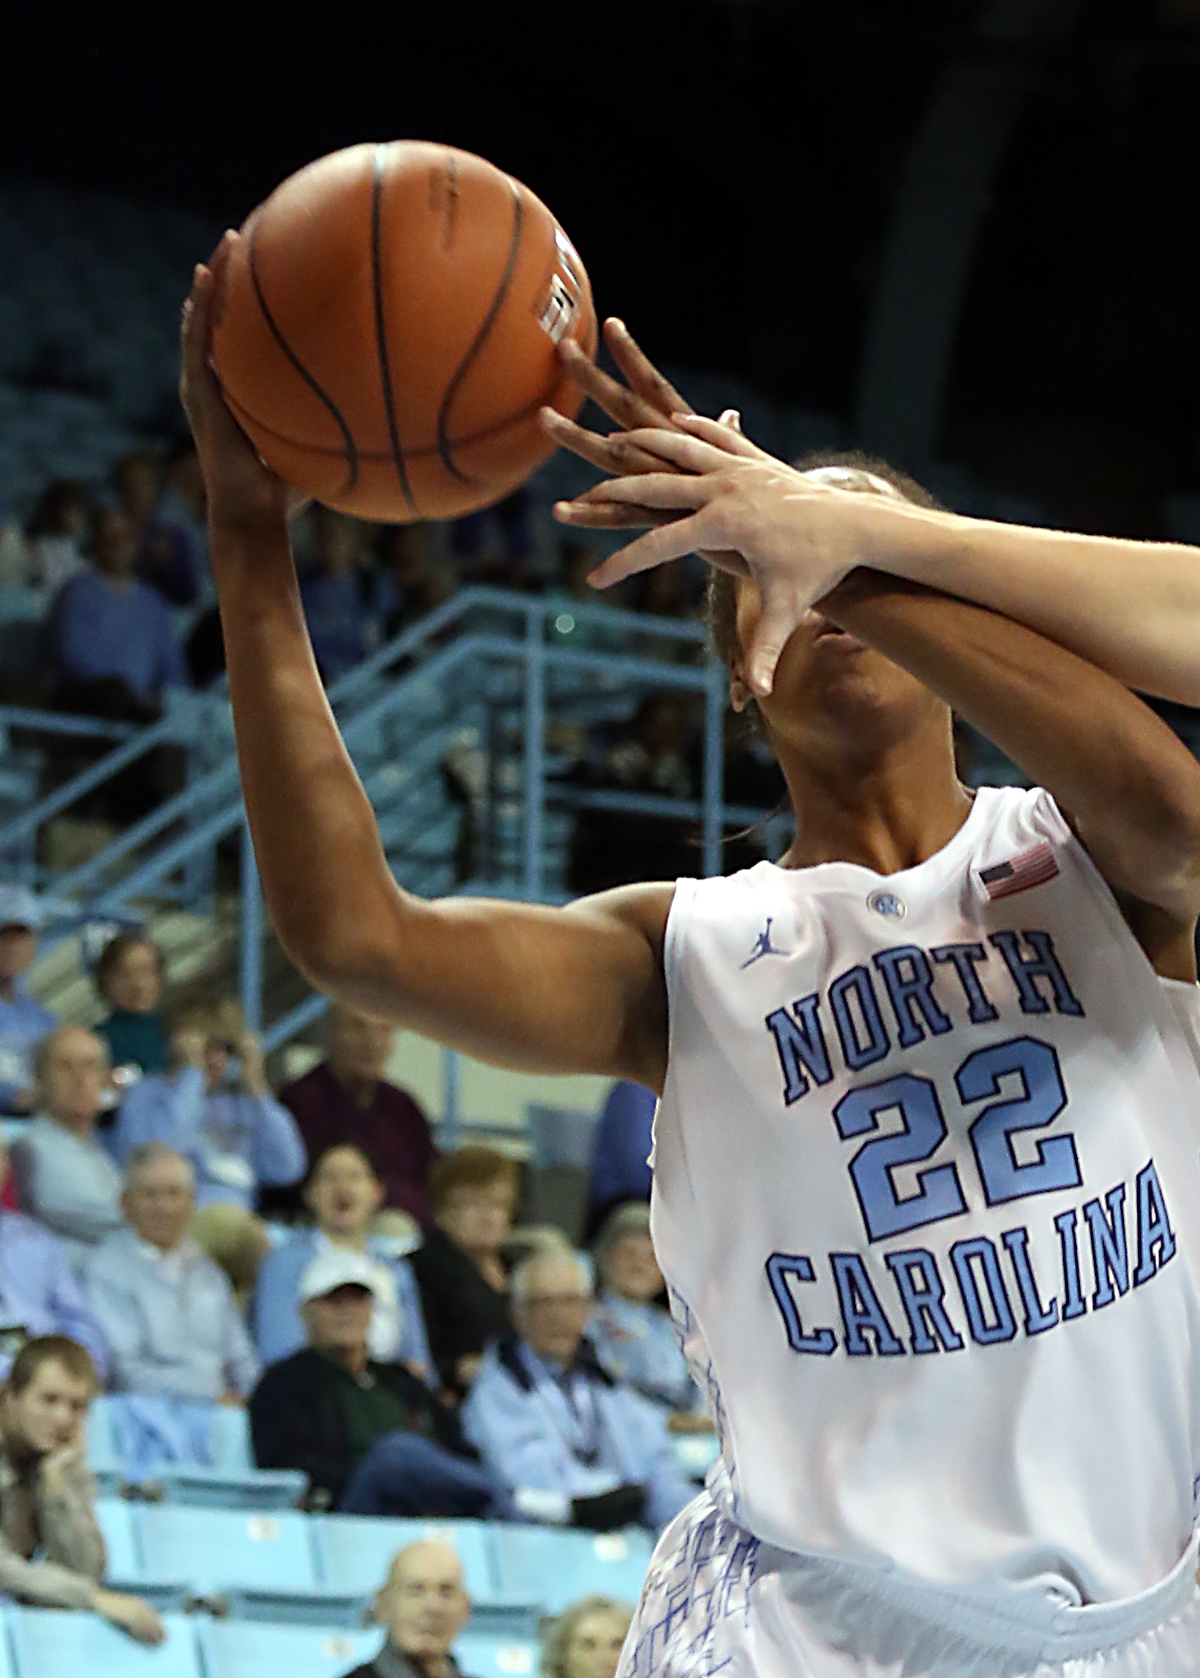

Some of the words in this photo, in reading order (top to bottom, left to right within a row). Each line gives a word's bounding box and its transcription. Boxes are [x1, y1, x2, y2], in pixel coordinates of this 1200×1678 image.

[765, 930, 1086, 1106] NORTH
[832, 1035, 1083, 1244] 22
[765, 1158, 1177, 1356] CAROLINA
